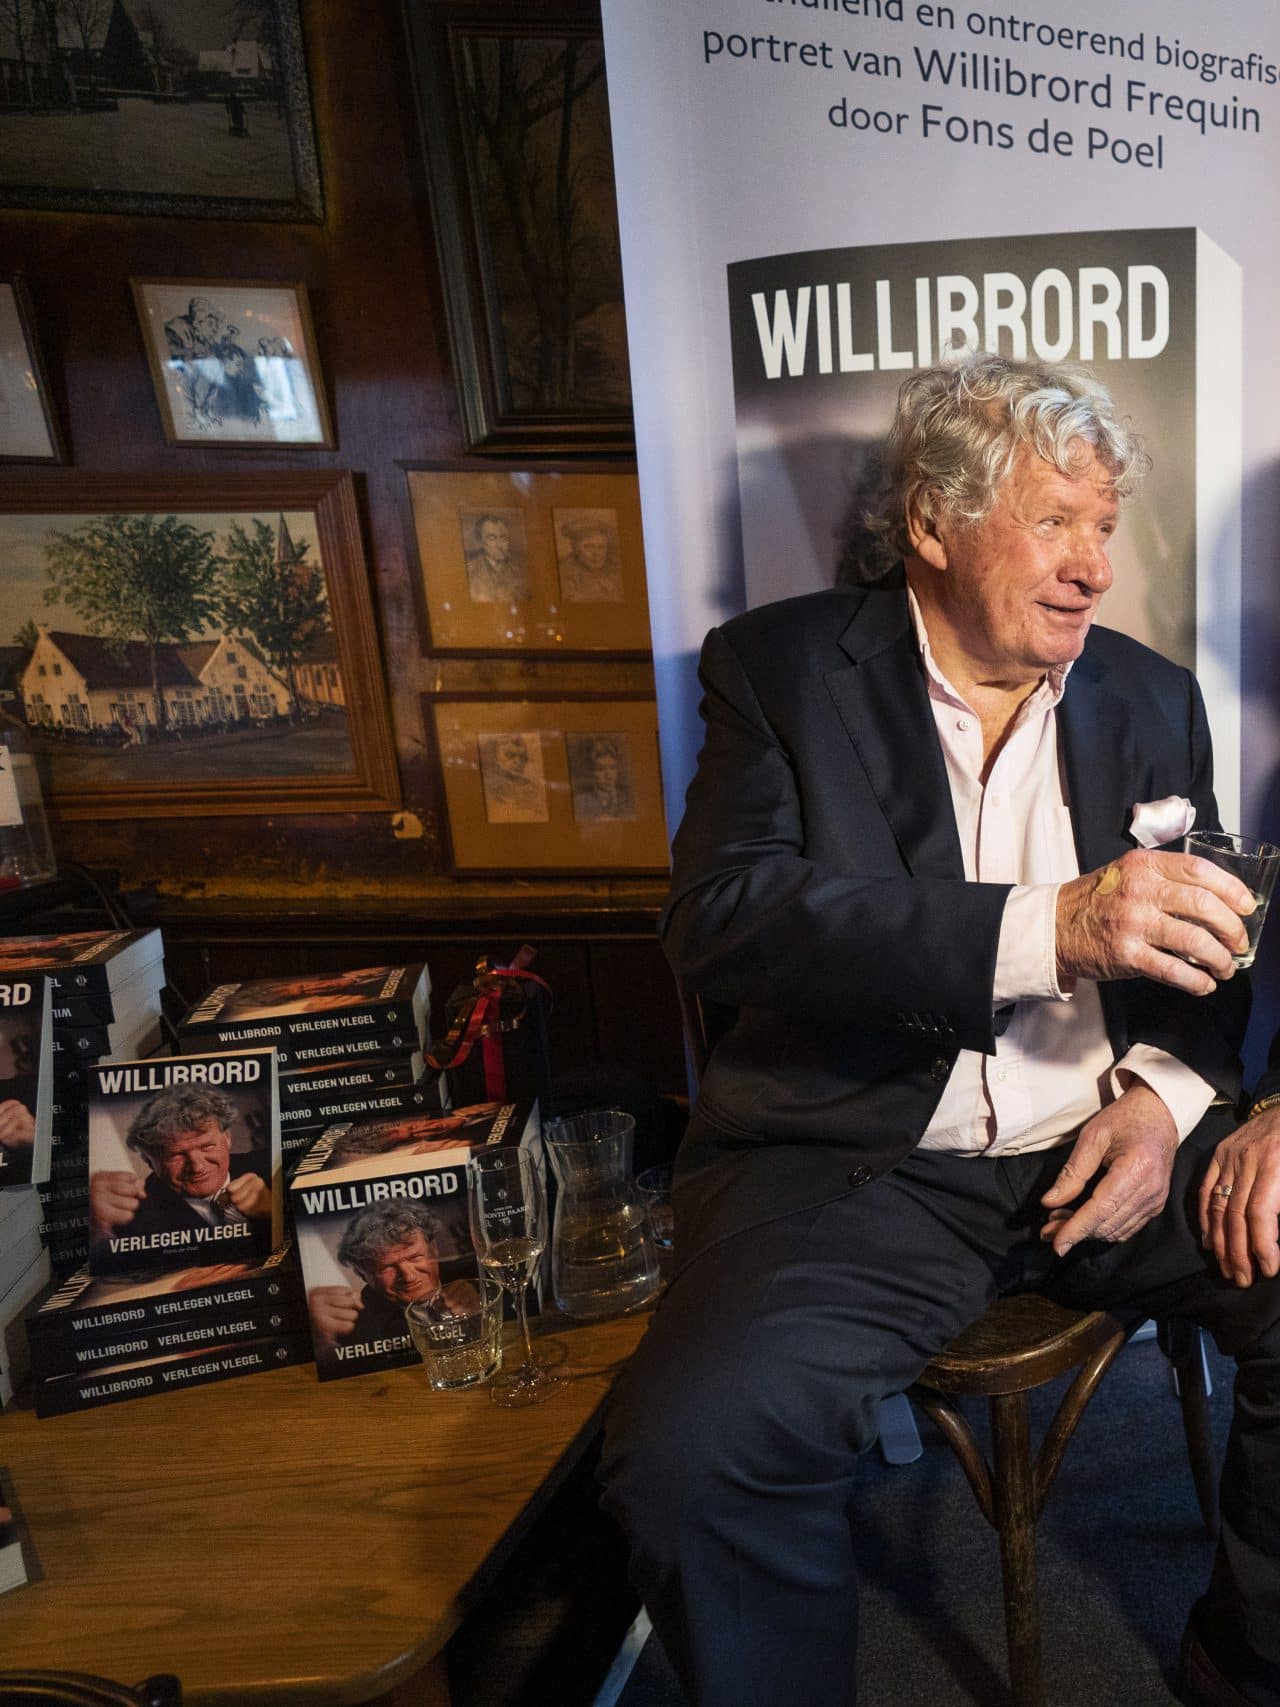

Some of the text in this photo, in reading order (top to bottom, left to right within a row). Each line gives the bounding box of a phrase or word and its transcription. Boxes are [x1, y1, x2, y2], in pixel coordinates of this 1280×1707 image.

[916, 3, 955, 29] en
[966, 10, 1145, 62] ontroerend
[703, 29, 1261, 135] portret van Willibrord Frequin
[828, 98, 1164, 169] door Fons de Poel
[751, 265, 1170, 379] WILLIBRORD
[218, 1015, 376, 1042] WILLIBRORD VERLEGEN VLEGEL
[295, 1045, 345, 1060] VERLEGEN
[346, 1040, 381, 1053] VLEGEL
[98, 1059, 261, 1095] WILLIBRORD
[287, 1073, 374, 1094] VERLEGEN VLEGEL
[279, 1097, 403, 1121] BRORD VERLEGEN VLEGEL
[301, 1172, 459, 1215] WILLIBRORD
[109, 1230, 191, 1254] VERLEGEN
[195, 1223, 252, 1243] VLEGEL
[72, 1289, 254, 1331] WILLIBRORD VERLEGEN VLEGEL
[76, 1320, 257, 1362] WILLIBRORD VERLEGEN VLEGEL
[335, 1335, 412, 1361] VERLEGEN
[80, 1353, 263, 1400] WILLIBRORD VERLEGEN VLEGEL
